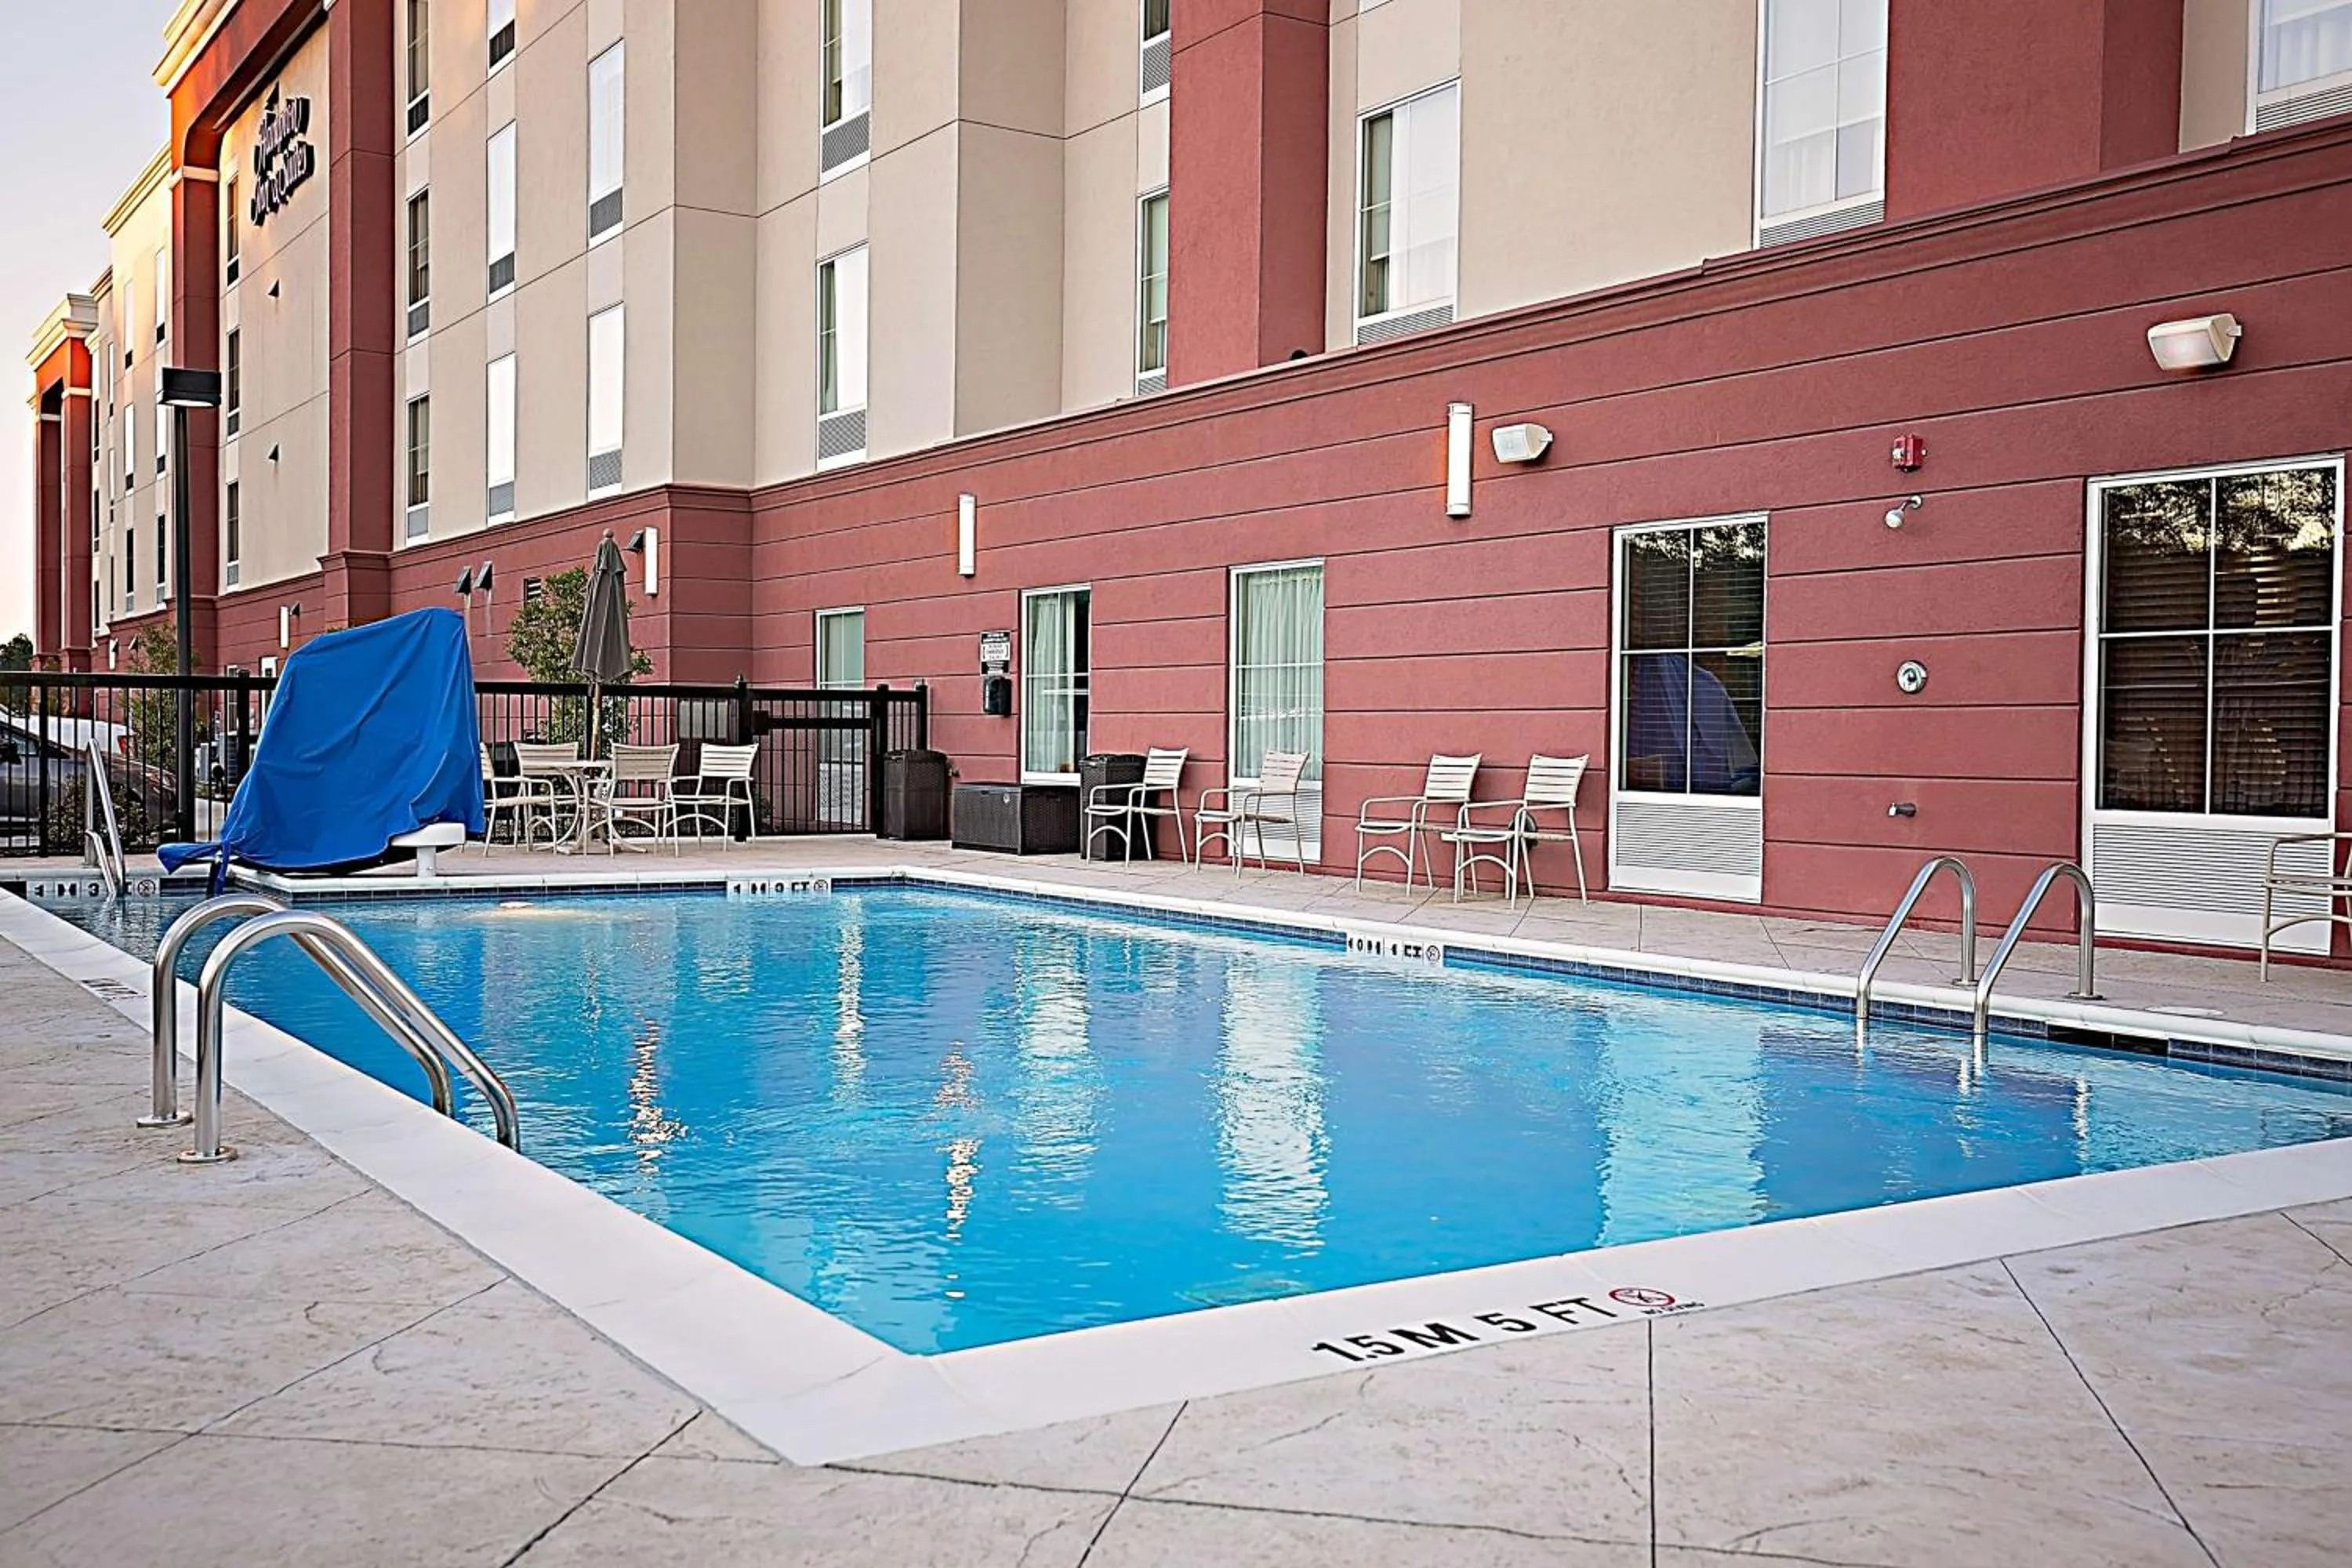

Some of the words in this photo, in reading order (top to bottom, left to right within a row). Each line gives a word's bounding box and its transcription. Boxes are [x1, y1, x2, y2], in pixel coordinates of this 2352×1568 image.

[1312, 1334, 1406, 1362] 1.5
[1388, 1322, 1480, 1348] M
[1474, 1312, 1537, 1332] 5
[1529, 1297, 1618, 1325] FT
